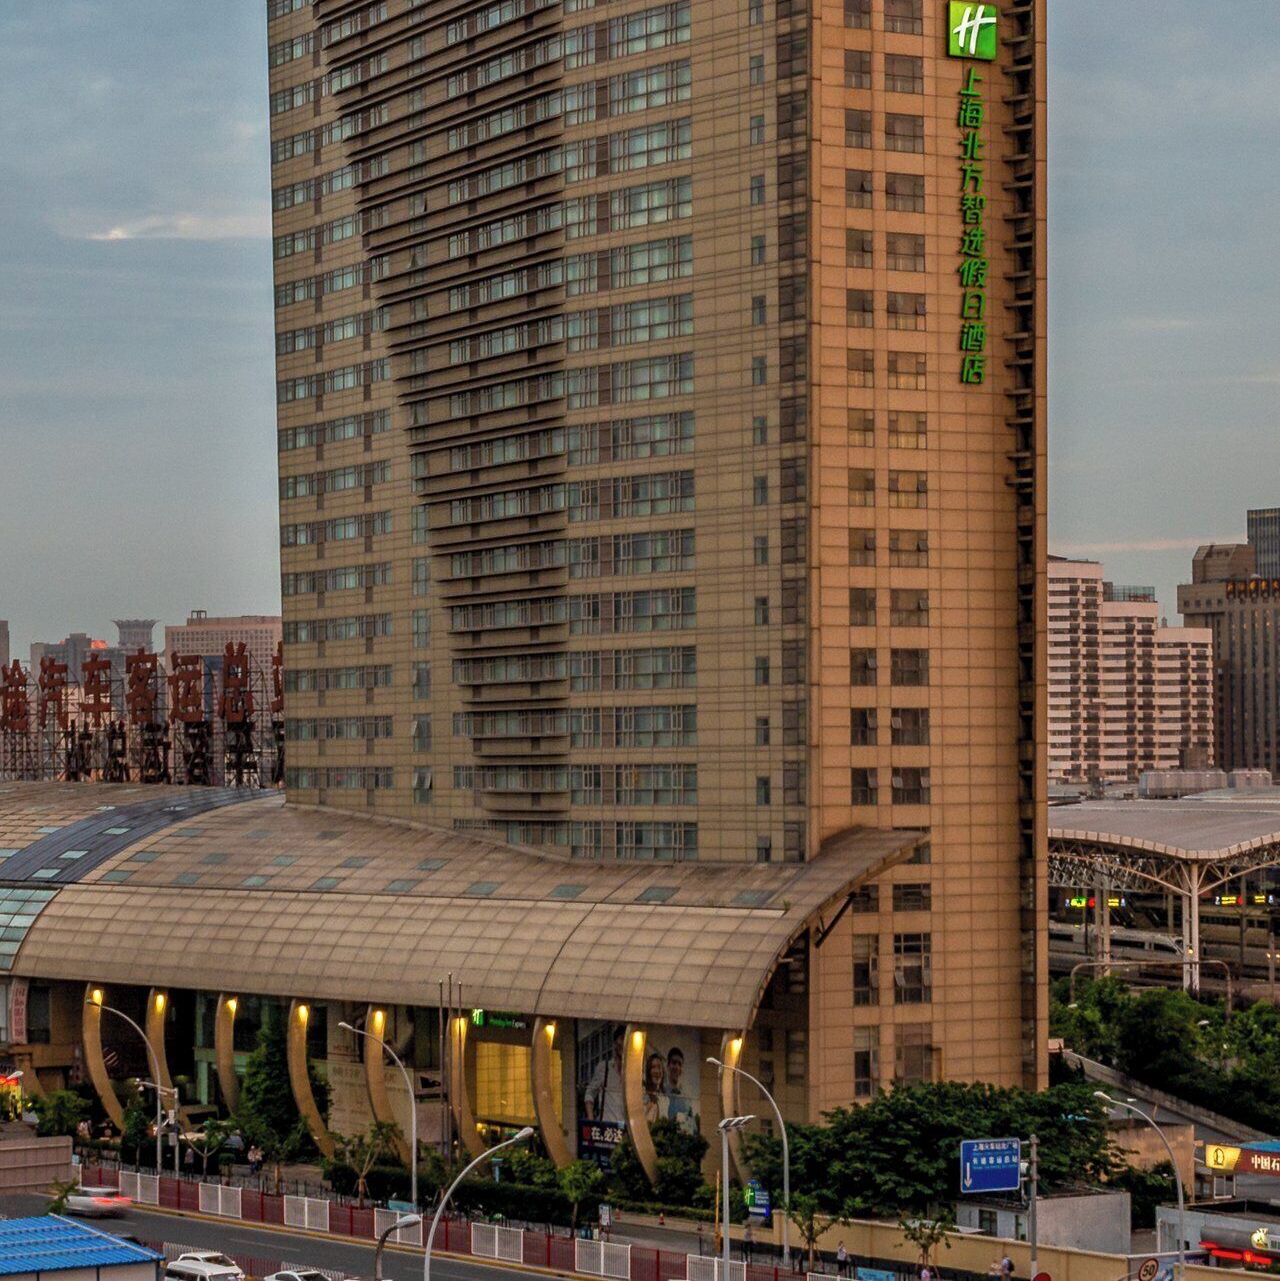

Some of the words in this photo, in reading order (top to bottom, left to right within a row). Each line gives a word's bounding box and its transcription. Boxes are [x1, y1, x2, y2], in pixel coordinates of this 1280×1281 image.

[957, 67, 987, 385] 上海北方智选假日酒店
[1142, 1264, 1156, 1278] 50
